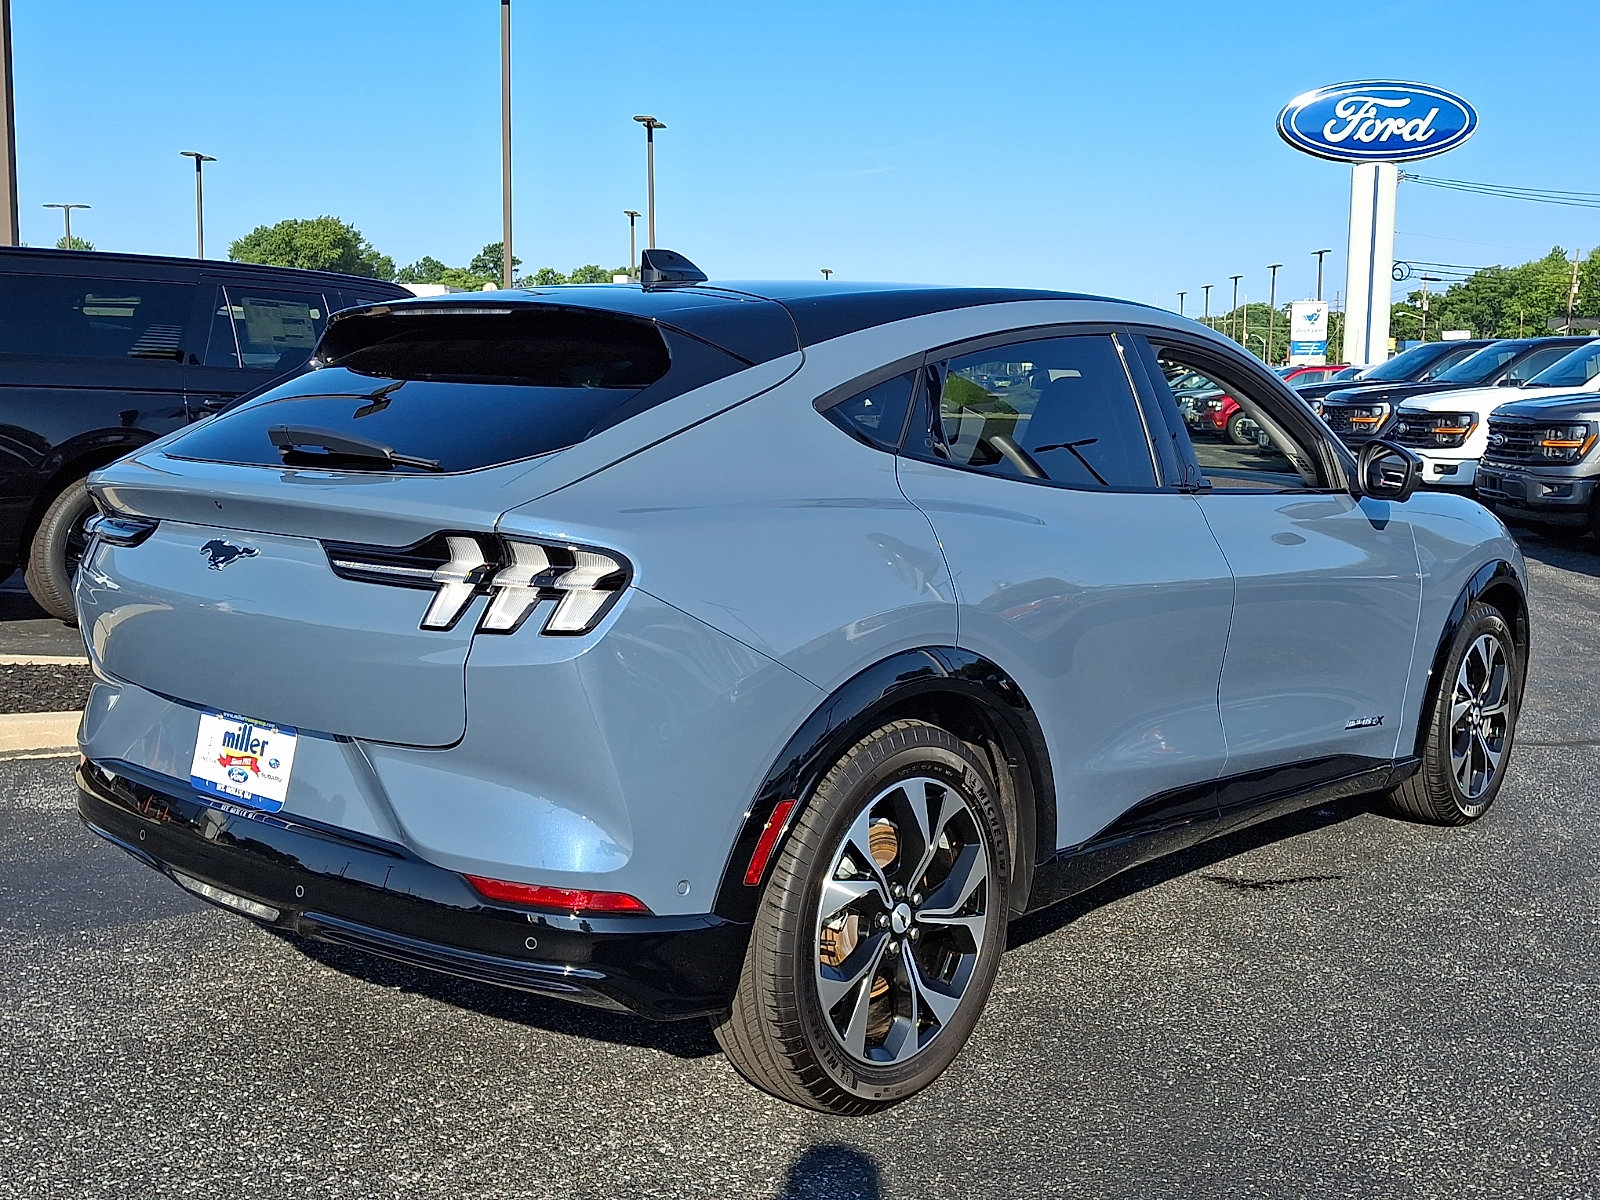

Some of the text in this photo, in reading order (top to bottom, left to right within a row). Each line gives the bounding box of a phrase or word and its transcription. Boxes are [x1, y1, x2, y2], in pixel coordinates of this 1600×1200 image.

[1322, 96, 1440, 143] Ford
[222, 724, 269, 756] miller
[976, 787, 1006, 871] MICHELIN
